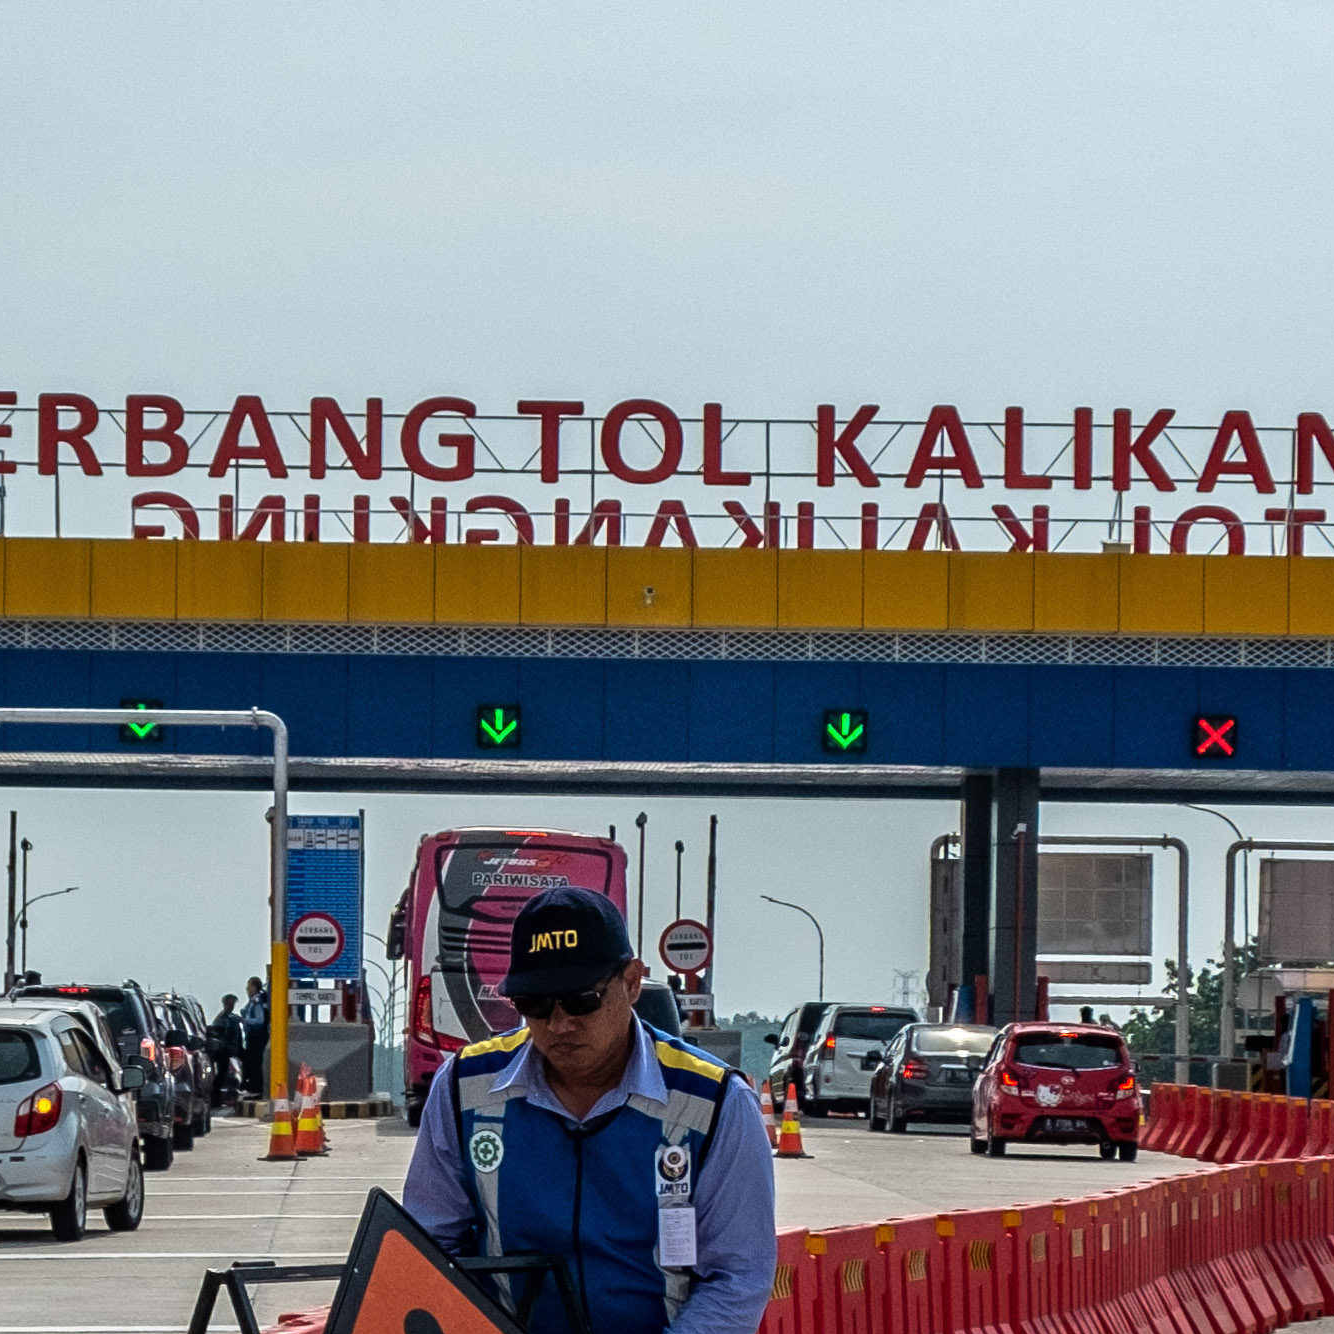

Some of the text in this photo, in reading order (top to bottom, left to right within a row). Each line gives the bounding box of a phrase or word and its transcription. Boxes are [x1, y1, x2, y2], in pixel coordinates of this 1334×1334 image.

[517, 398, 753, 487] TOL
[472, 872, 569, 888] PARIWISATA
[528, 929, 579, 953] JMTO
[658, 1182, 688, 1195] JMTO
